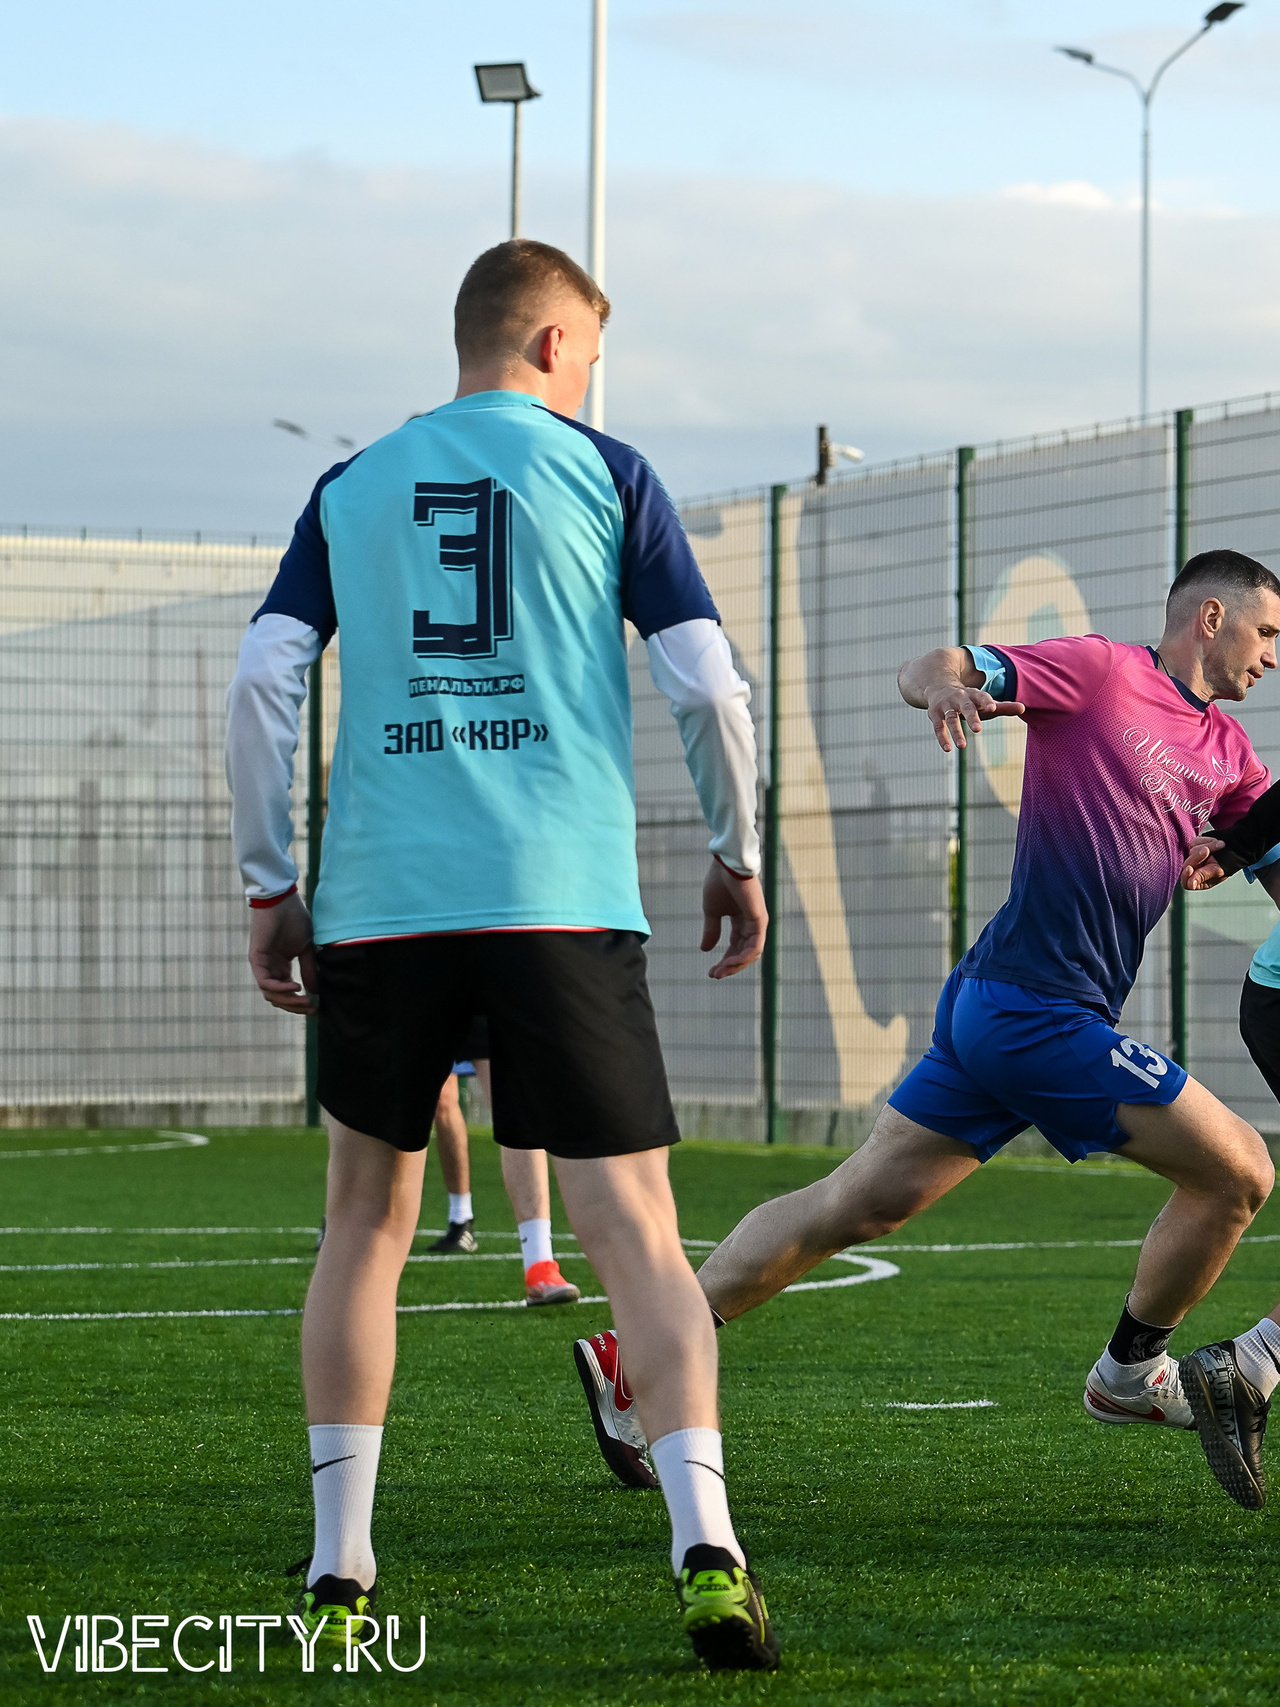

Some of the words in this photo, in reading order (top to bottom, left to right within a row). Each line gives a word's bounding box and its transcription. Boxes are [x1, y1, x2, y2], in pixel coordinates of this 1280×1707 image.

[412, 477, 514, 661] 3
[409, 674, 525, 698] ПЕНАЛЬТИ.РФ
[384, 719, 444, 755] ЗАО
[452, 718, 549, 751] «КВР»
[1110, 1038, 1168, 1089] 13
[1210, 1367, 1233, 1406] JUST
